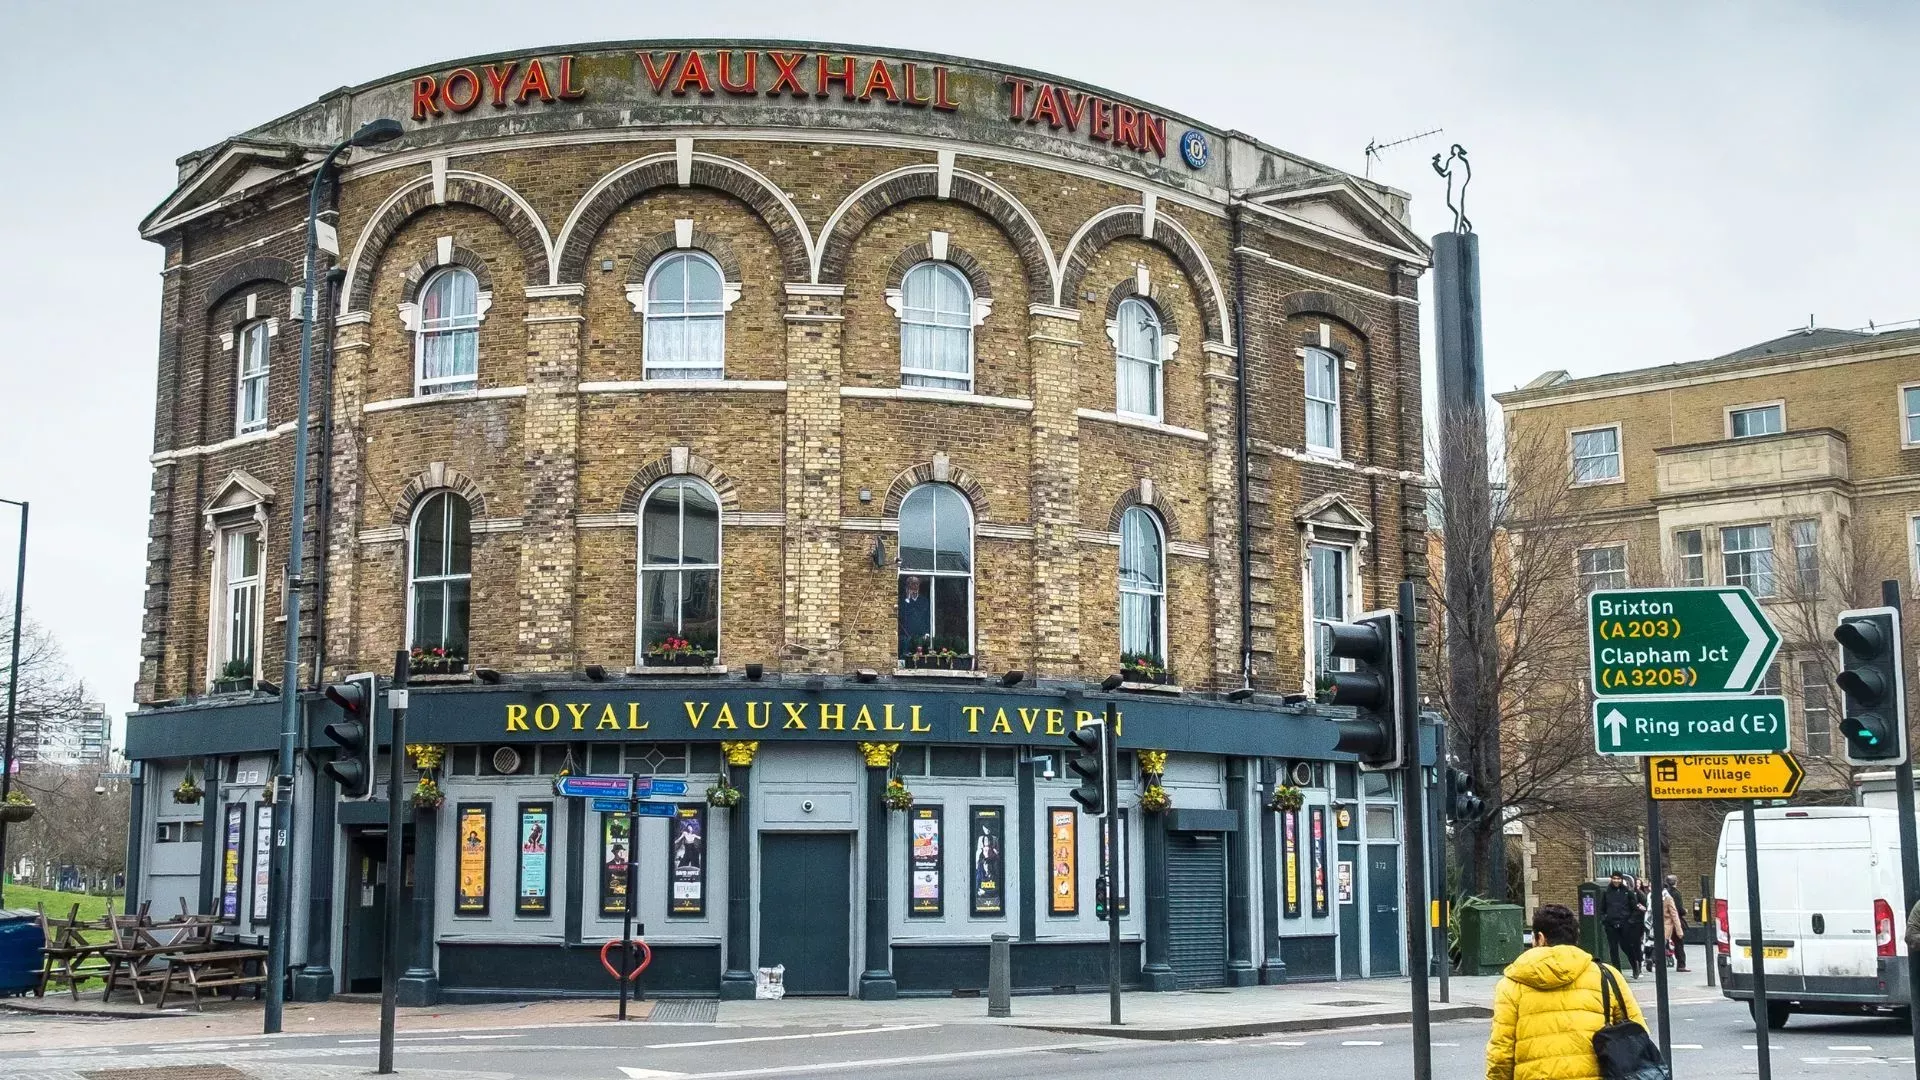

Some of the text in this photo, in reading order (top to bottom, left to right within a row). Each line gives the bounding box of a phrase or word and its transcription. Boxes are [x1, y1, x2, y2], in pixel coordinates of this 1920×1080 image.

[411, 49, 1168, 158] ROYAL VAUXHALL TAVERN
[1599, 599, 1673, 616] Brixton
[1599, 619, 1681, 640] (A203)
[1601, 645, 1729, 667] Clapham Jct
[1602, 667, 1697, 688] (A3205)
[505, 702, 649, 731] ROYAL
[684, 702, 931, 732] VAUXHALL
[1635, 712, 1778, 736] Ring road (E)
[1682, 755, 1770, 766] Circus West
[1703, 769, 1751, 781] Village
[1654, 784, 1779, 795] Battersea Power Station
[1767, 948, 1784, 957] DYP
